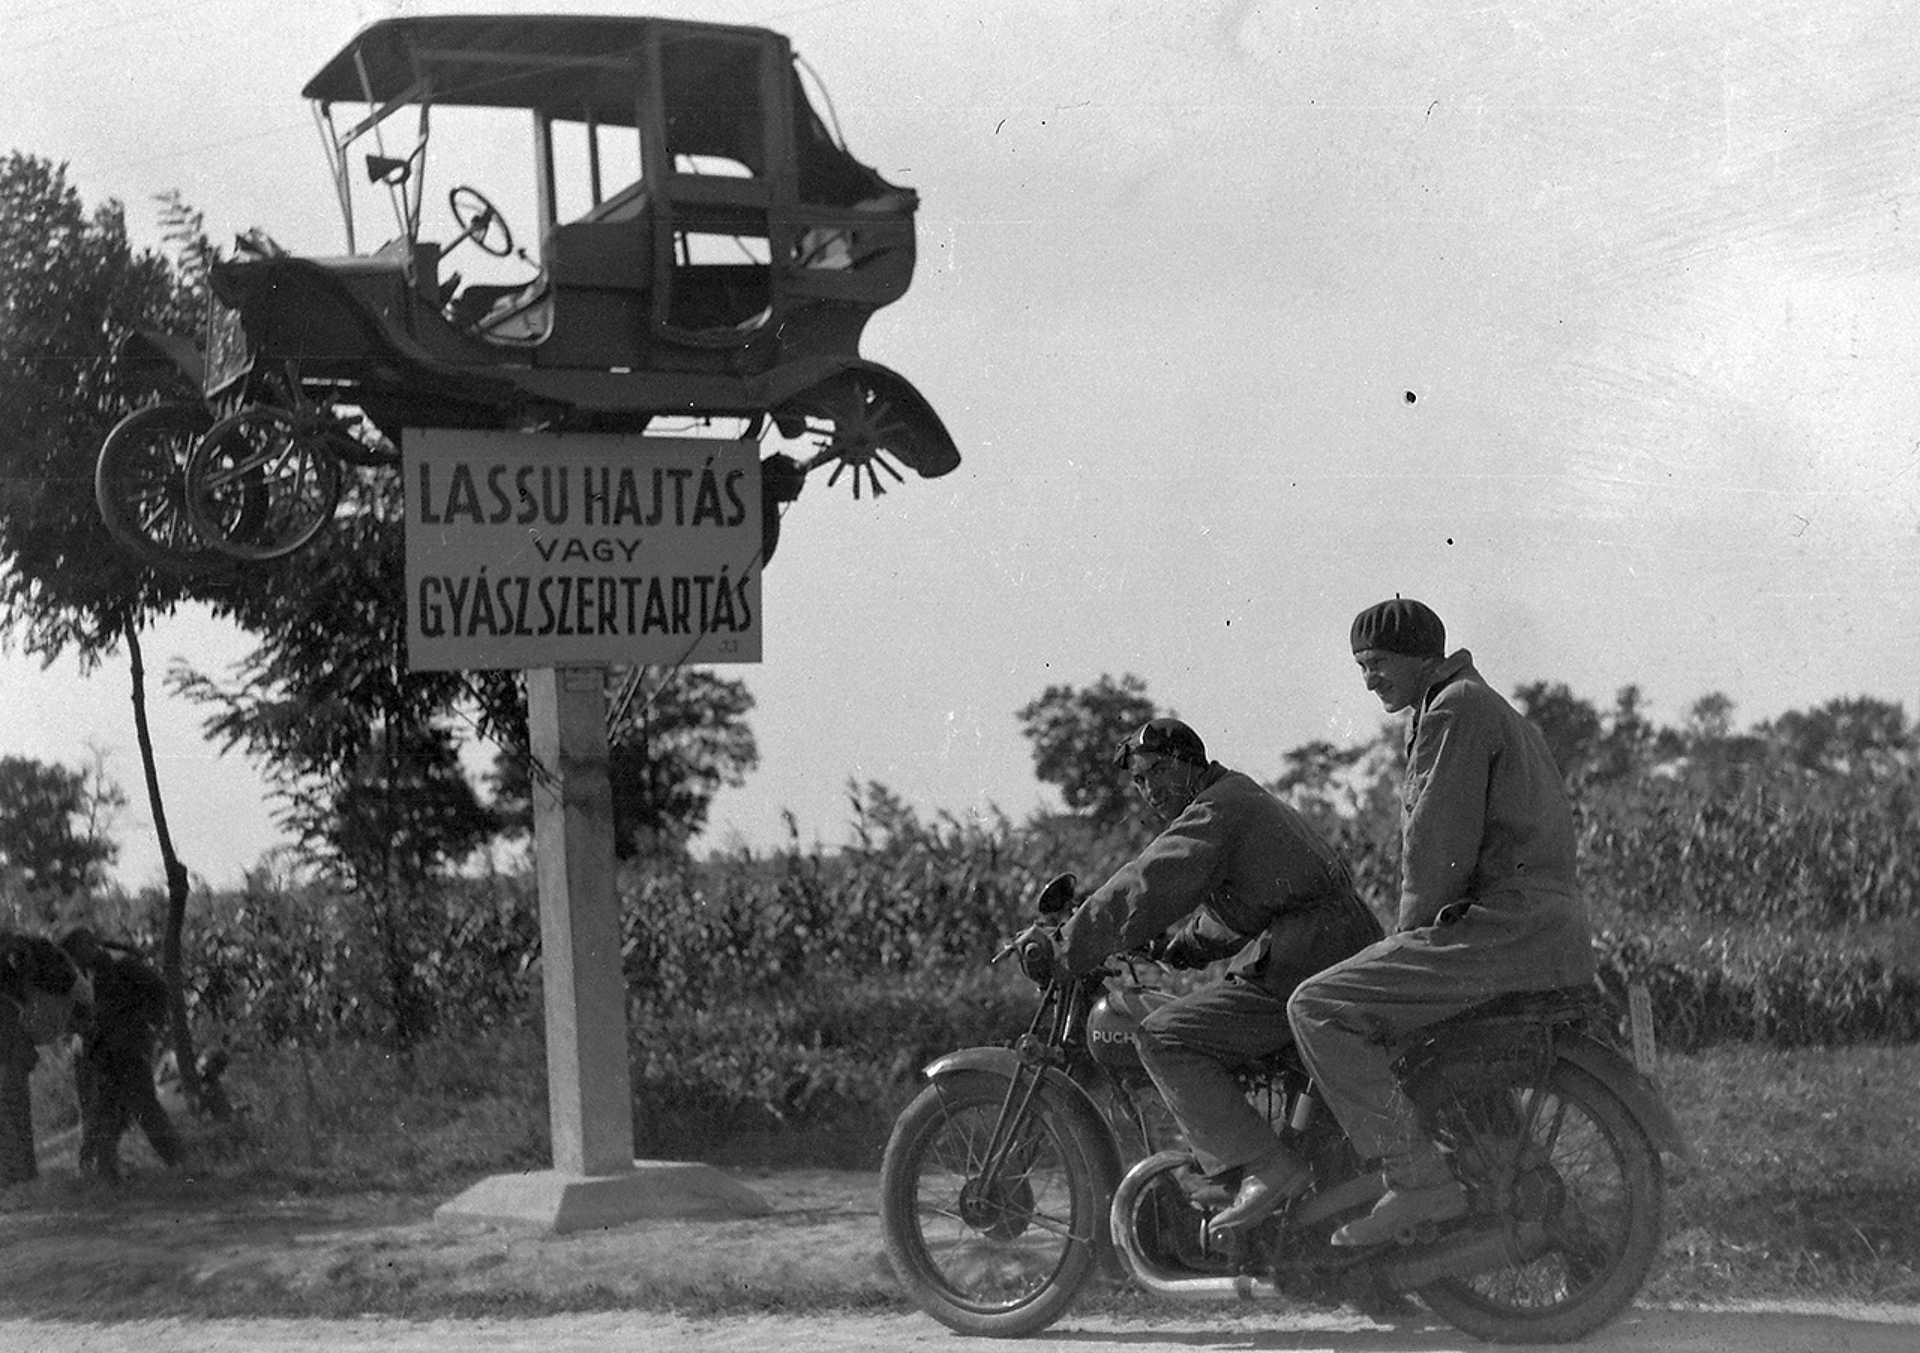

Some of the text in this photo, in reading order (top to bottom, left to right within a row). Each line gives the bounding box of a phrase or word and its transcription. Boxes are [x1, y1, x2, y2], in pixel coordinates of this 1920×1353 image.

[419, 456, 747, 528] LASSU HAJTÁS
[533, 538, 643, 563] VAGY
[419, 565, 752, 638] GYÁSZSZERTARTÁS
[1092, 1029, 1137, 1045] PUCH
